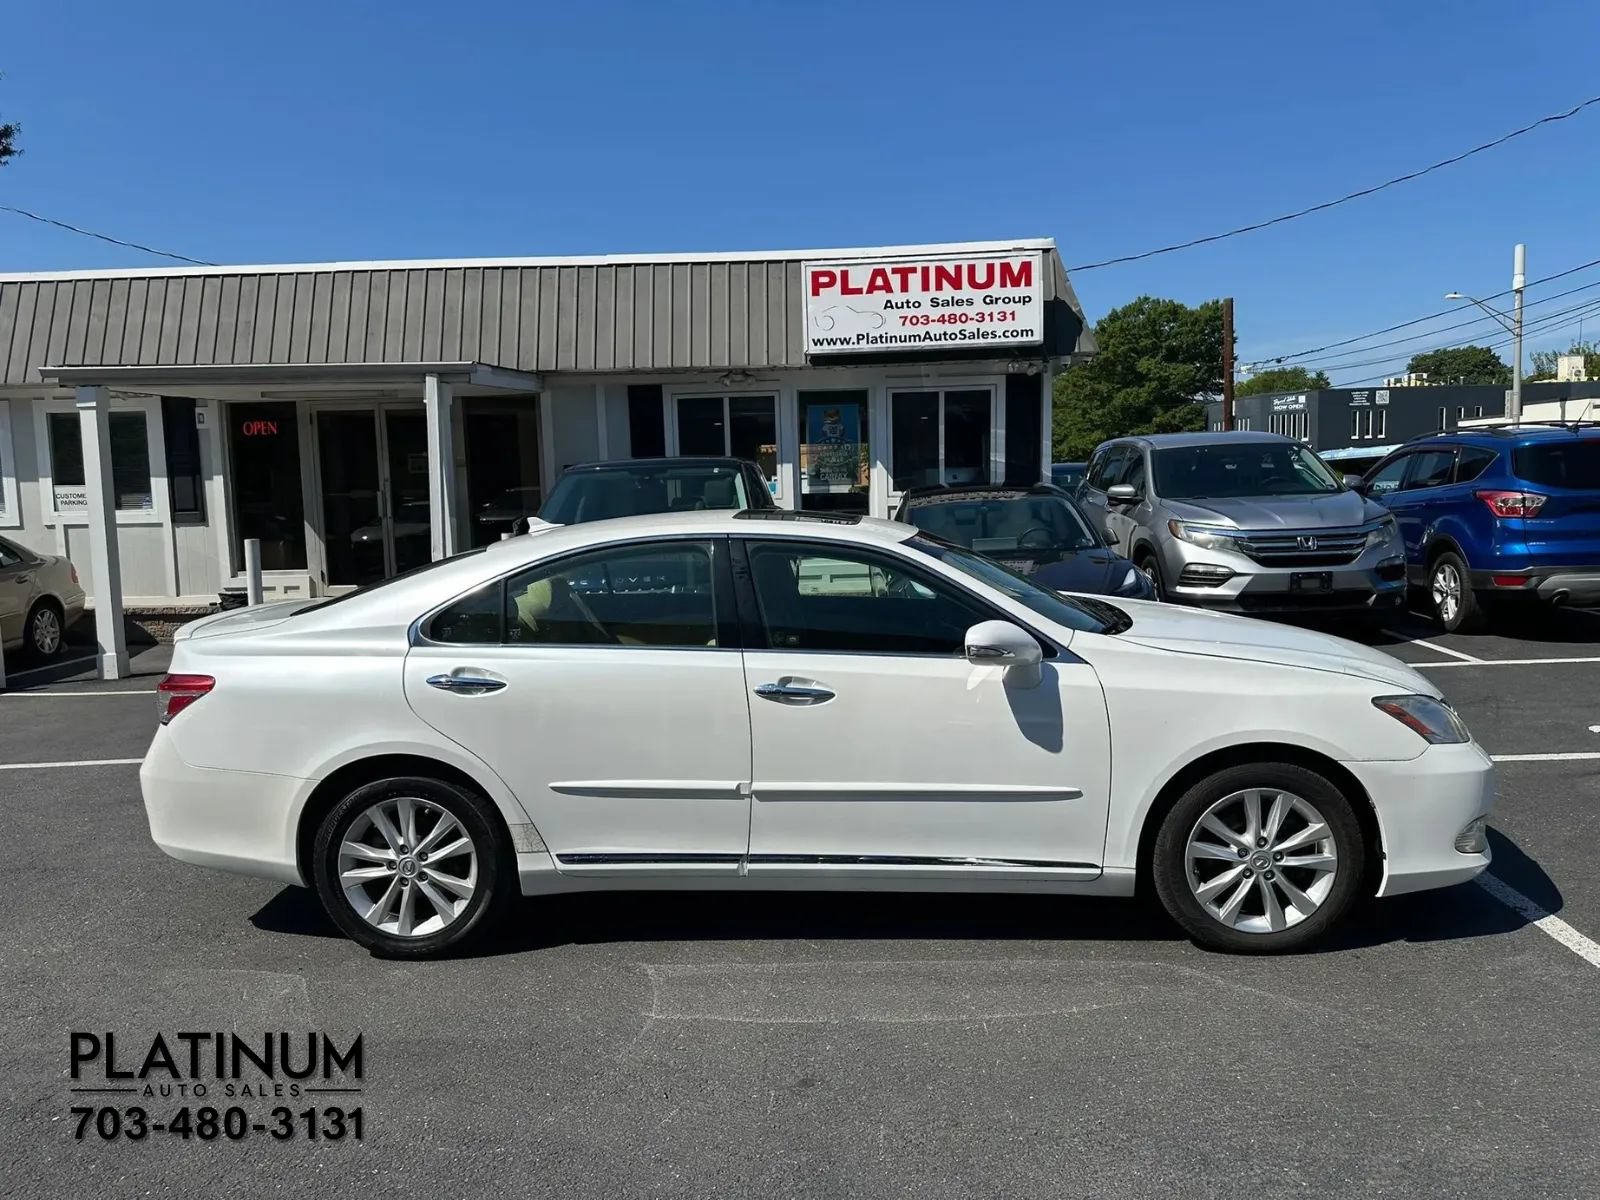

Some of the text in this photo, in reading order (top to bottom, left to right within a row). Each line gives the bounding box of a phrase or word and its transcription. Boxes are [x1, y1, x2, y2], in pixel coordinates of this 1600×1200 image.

[811, 260, 1033, 297] PLATINUM
[883, 294, 1033, 311] Auto Sales Group
[898, 310, 1017, 327] 703-480-3131
[811, 327, 1035, 347] www.PlatinumAutoSales.com
[242, 421, 278, 436] OPEN
